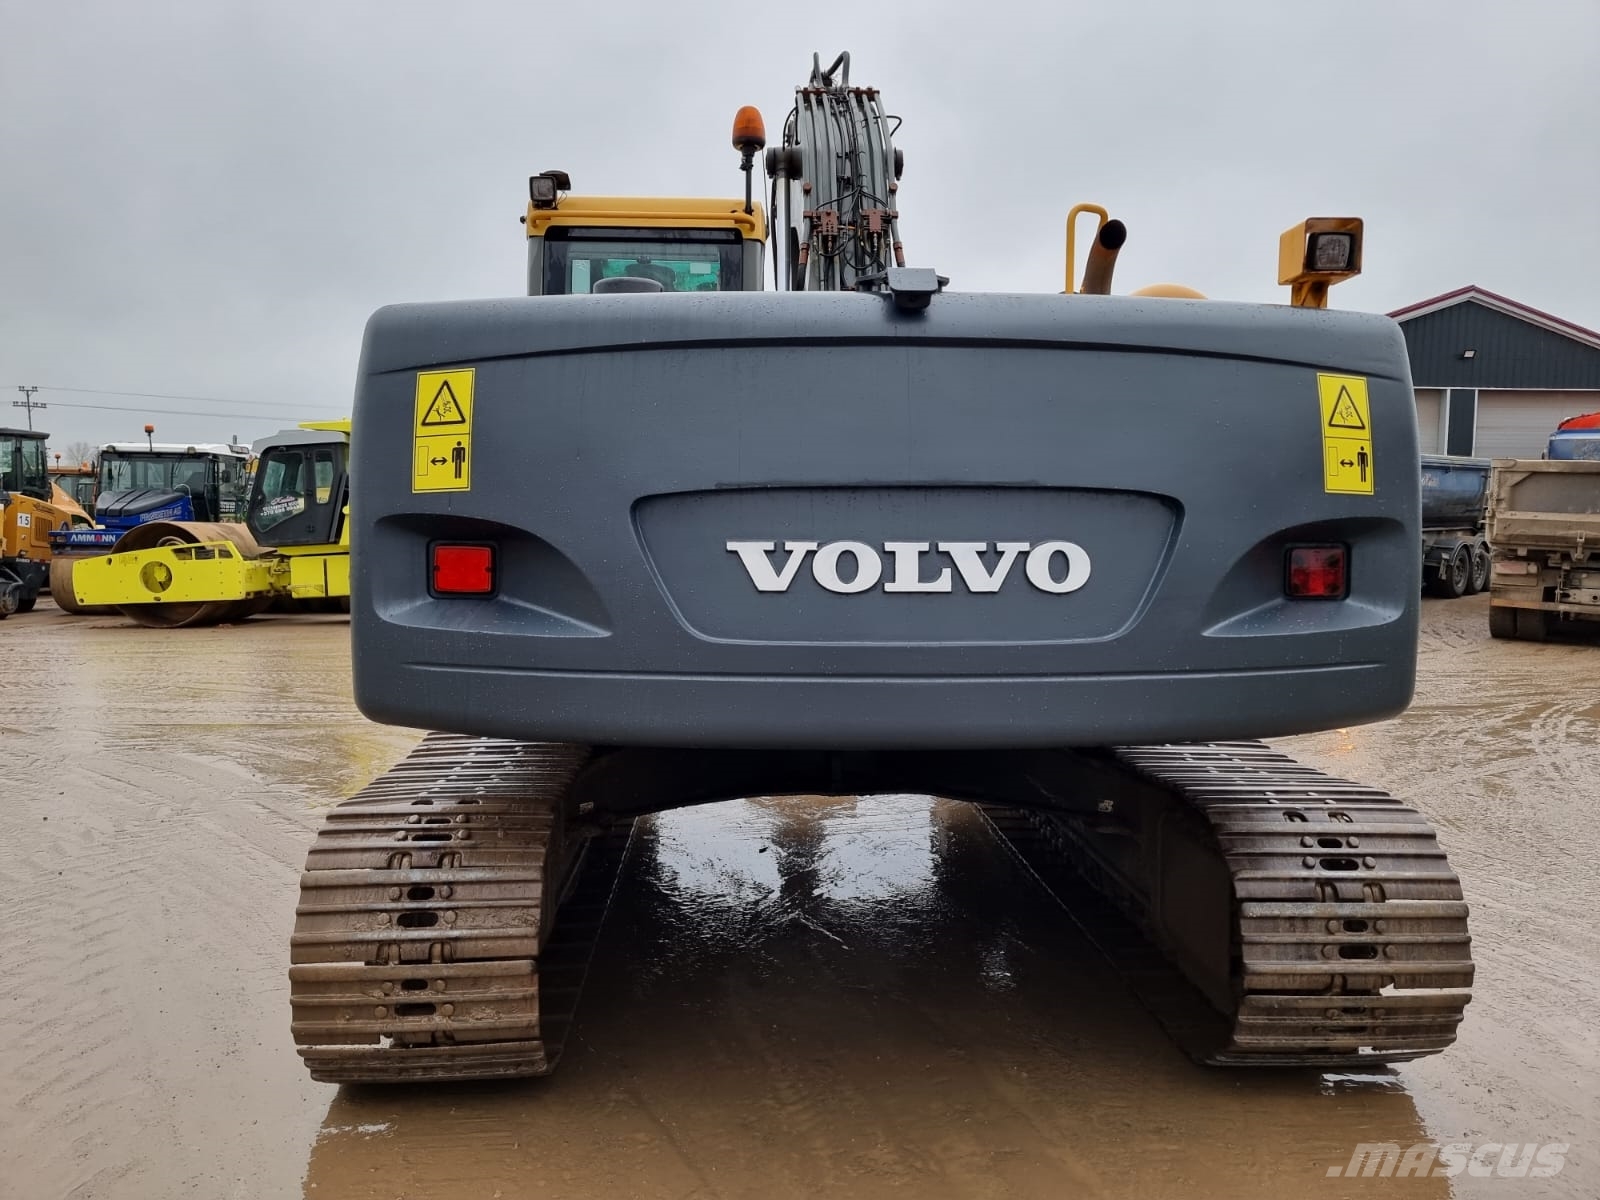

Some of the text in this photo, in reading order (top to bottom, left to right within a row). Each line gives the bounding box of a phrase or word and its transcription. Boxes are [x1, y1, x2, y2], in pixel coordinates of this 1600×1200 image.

[19, 515, 30, 525] 15
[70, 534, 116, 543] AMMANN
[726, 541, 1092, 593] VOLVO
